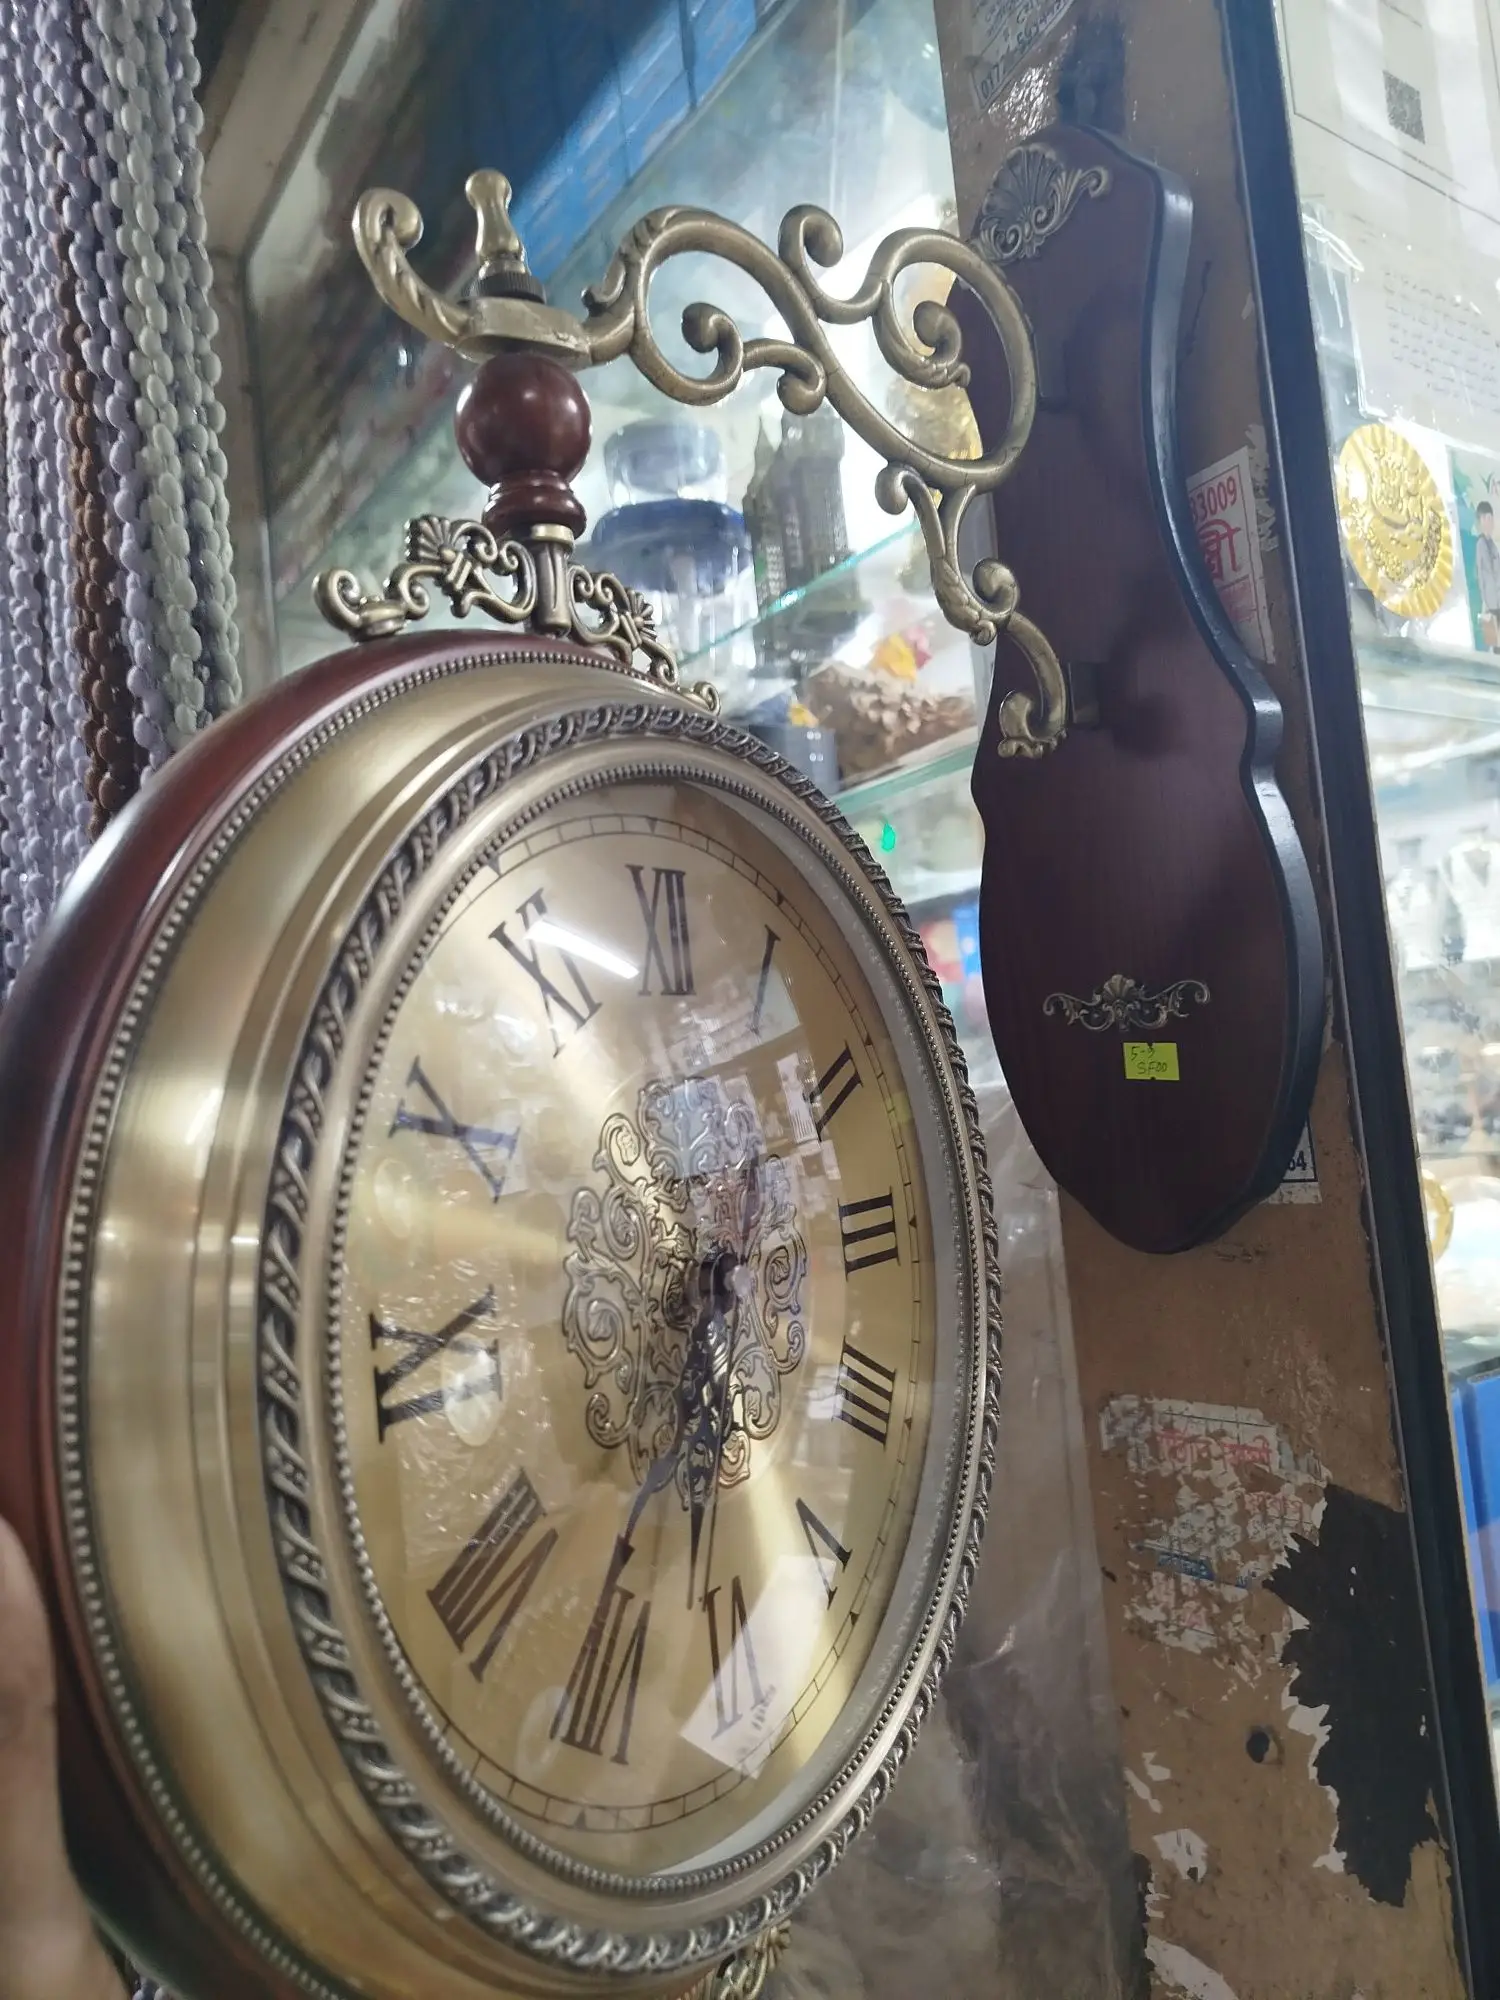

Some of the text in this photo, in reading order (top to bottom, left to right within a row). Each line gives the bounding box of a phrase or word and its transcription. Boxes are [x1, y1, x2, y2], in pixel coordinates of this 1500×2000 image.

[488, 887, 602, 1059] XI
[625, 864, 696, 997] XII
[747, 924, 780, 1034] I
[387, 1055, 520, 1203] X
[802, 1040, 864, 1142] II
[838, 1185, 898, 1282] III
[369, 1283, 503, 1444] IX
[426, 1466, 560, 1683] VIII
[795, 1497, 852, 1610] V
[560, 1586, 650, 1766] VII
[700, 1576, 767, 1740] VI
